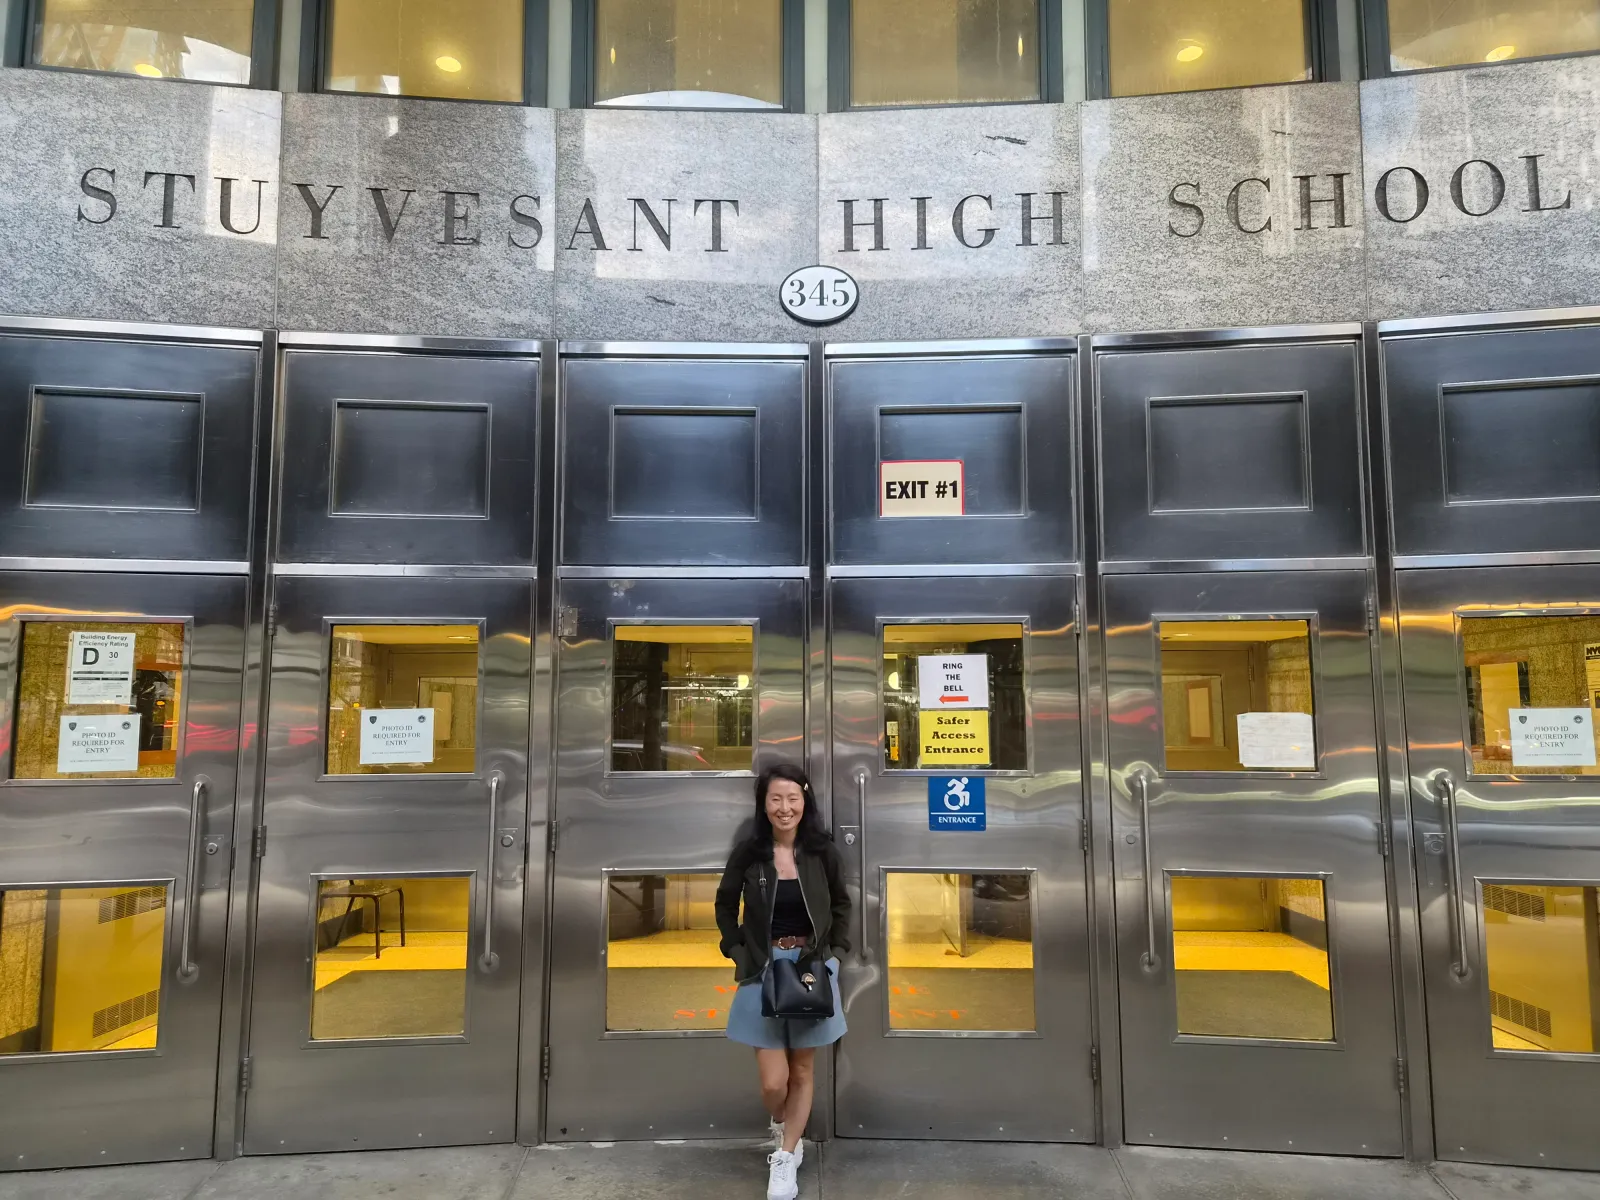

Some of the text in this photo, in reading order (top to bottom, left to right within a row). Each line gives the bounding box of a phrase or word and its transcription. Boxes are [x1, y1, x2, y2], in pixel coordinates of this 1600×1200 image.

[77, 153, 1572, 252] STUYVESANT HIGH SCHOOL
[788, 277, 850, 307] 345
[885, 480, 958, 500] EXIT #1
[78, 640, 108, 648] Efficiency
[82, 647, 100, 666] D
[108, 651, 119, 659] 30
[942, 662, 964, 670] RING
[945, 673, 961, 681] THE
[943, 684, 964, 692] BELL
[936, 716, 971, 726] Safer
[372, 732, 407, 740] REQUIRED
[931, 731, 976, 740] Access
[1524, 733, 1563, 741] REQUIRED
[72, 739, 109, 747] REQUIRED
[924, 745, 985, 755] Entrance
[938, 815, 977, 824] ENTRANCE
